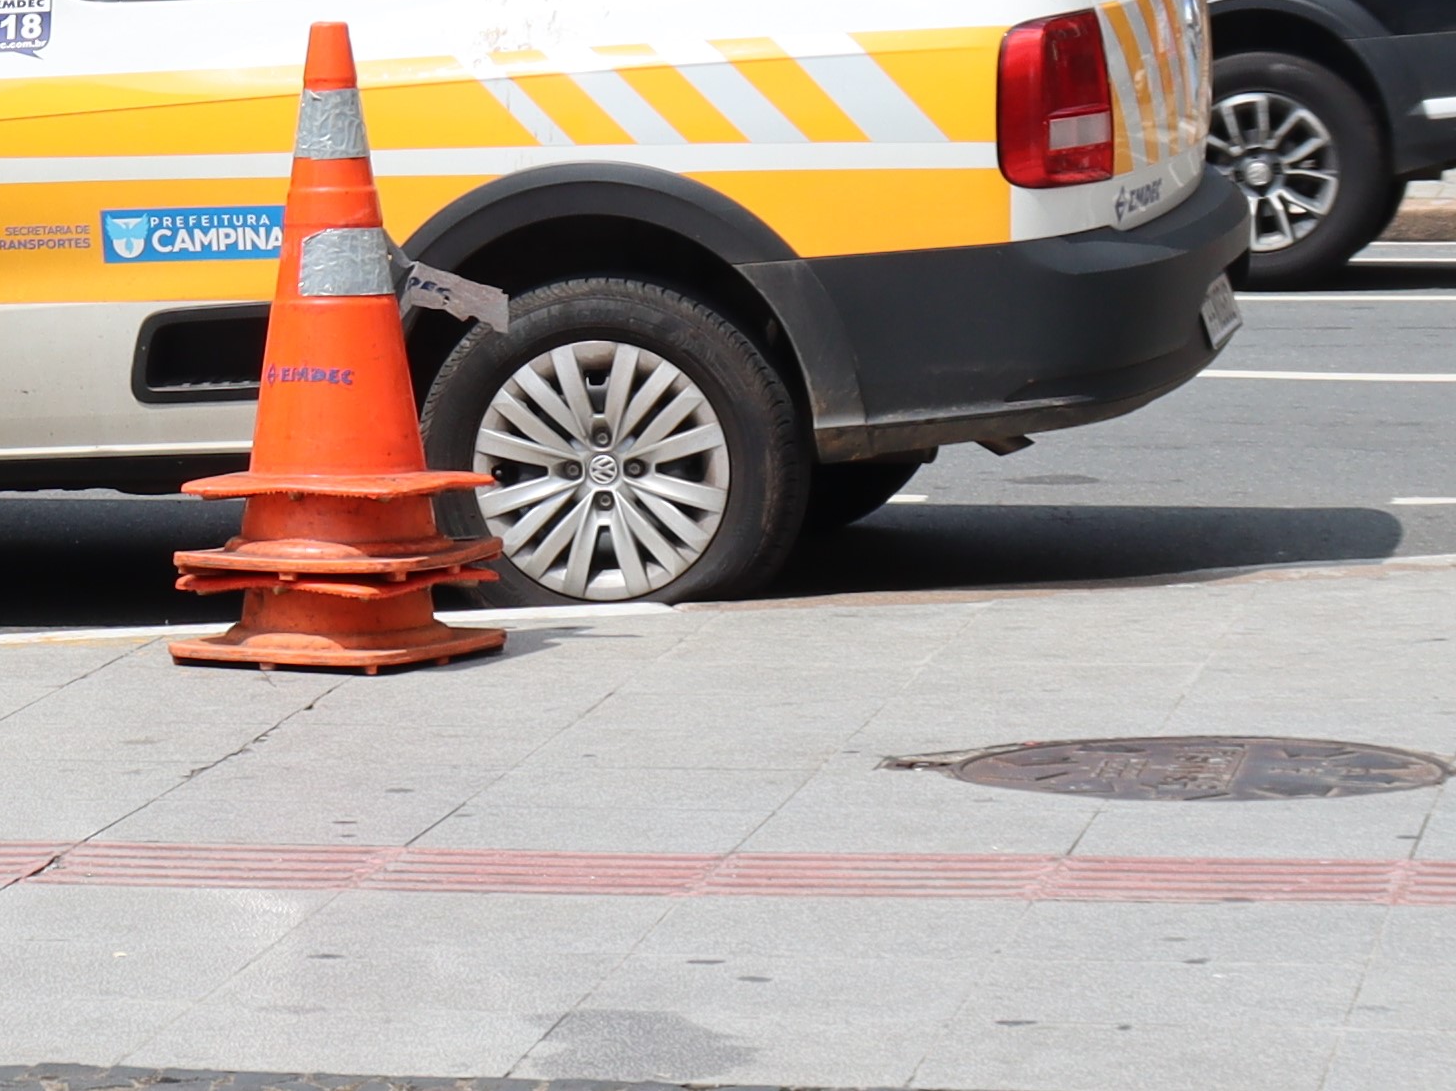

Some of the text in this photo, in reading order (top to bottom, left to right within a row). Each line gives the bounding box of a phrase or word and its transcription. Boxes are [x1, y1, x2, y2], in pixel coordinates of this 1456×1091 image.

[150, 213, 271, 228] PREFEITURA
[4, 224, 91, 237] SECRETARIA DE
[280, 367, 356, 386] EMDEC
